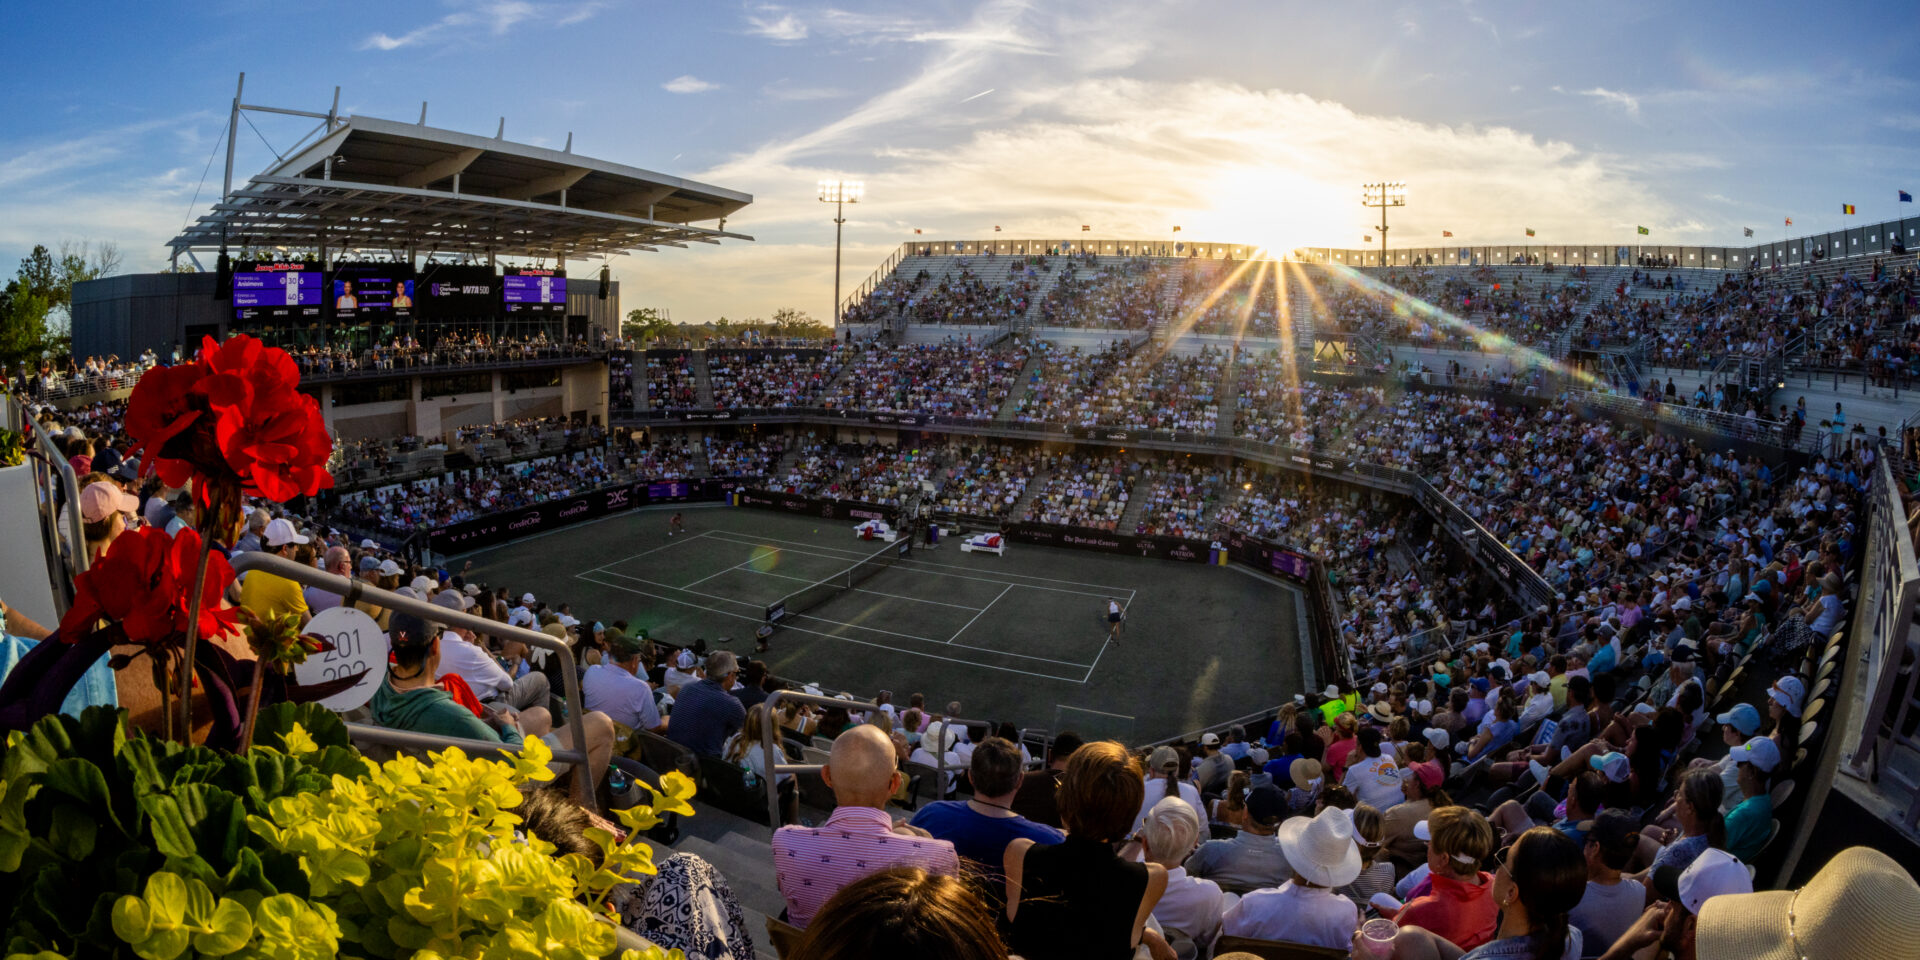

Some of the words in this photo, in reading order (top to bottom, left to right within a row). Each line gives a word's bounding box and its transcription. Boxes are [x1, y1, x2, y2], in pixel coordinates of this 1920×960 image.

[287, 277, 298, 285] 30
[299, 277, 304, 285] 6
[480, 285, 490, 295] 500
[287, 293, 298, 301] 40
[299, 293, 304, 301] 5
[508, 516, 542, 530] CreditOne
[323, 628, 361, 663] 201
